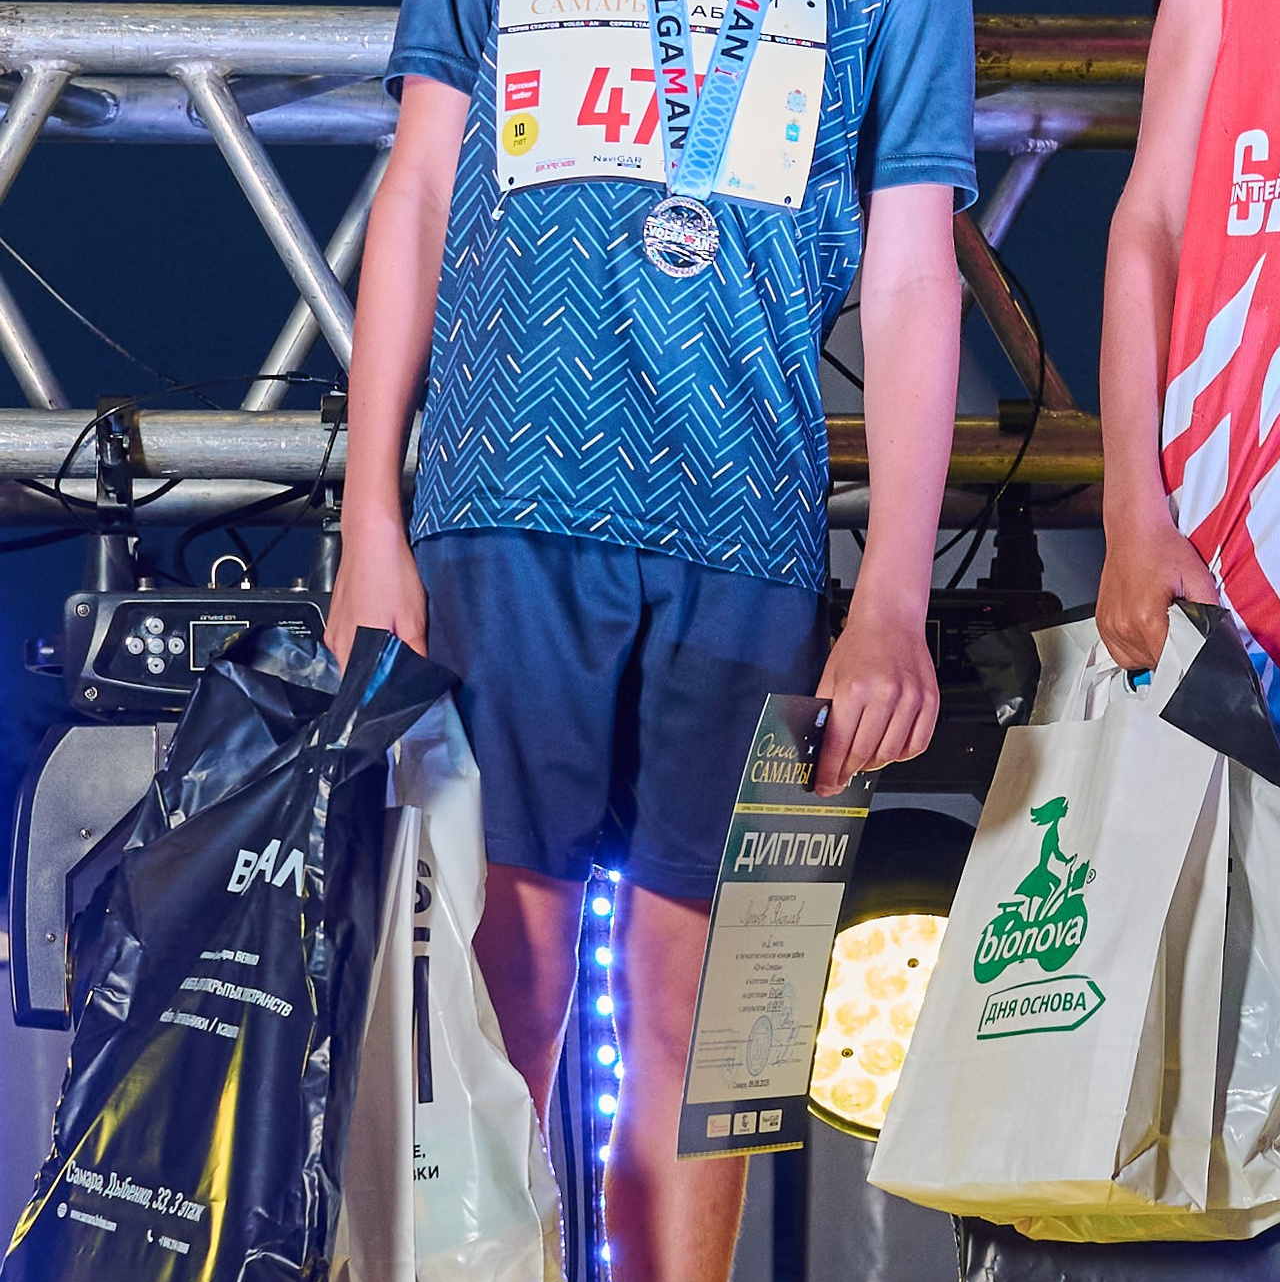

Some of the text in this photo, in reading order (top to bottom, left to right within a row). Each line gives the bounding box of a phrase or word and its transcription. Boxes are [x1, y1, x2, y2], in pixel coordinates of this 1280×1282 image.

[577, 67, 705, 146] 47
[513, 137, 527, 148] лет
[514, 122, 525, 138] 10
[756, 733, 799, 760] Огни
[751, 760, 814, 785] САМАРЫ
[734, 832, 849, 873] ДИПЛОМ
[978, 916, 1084, 965] bionova
[985, 992, 1087, 1025] ДНЯ ОСНОВА
[66, 1160, 104, 1195] Самара,
[169, 1193, 184, 1215] 3
